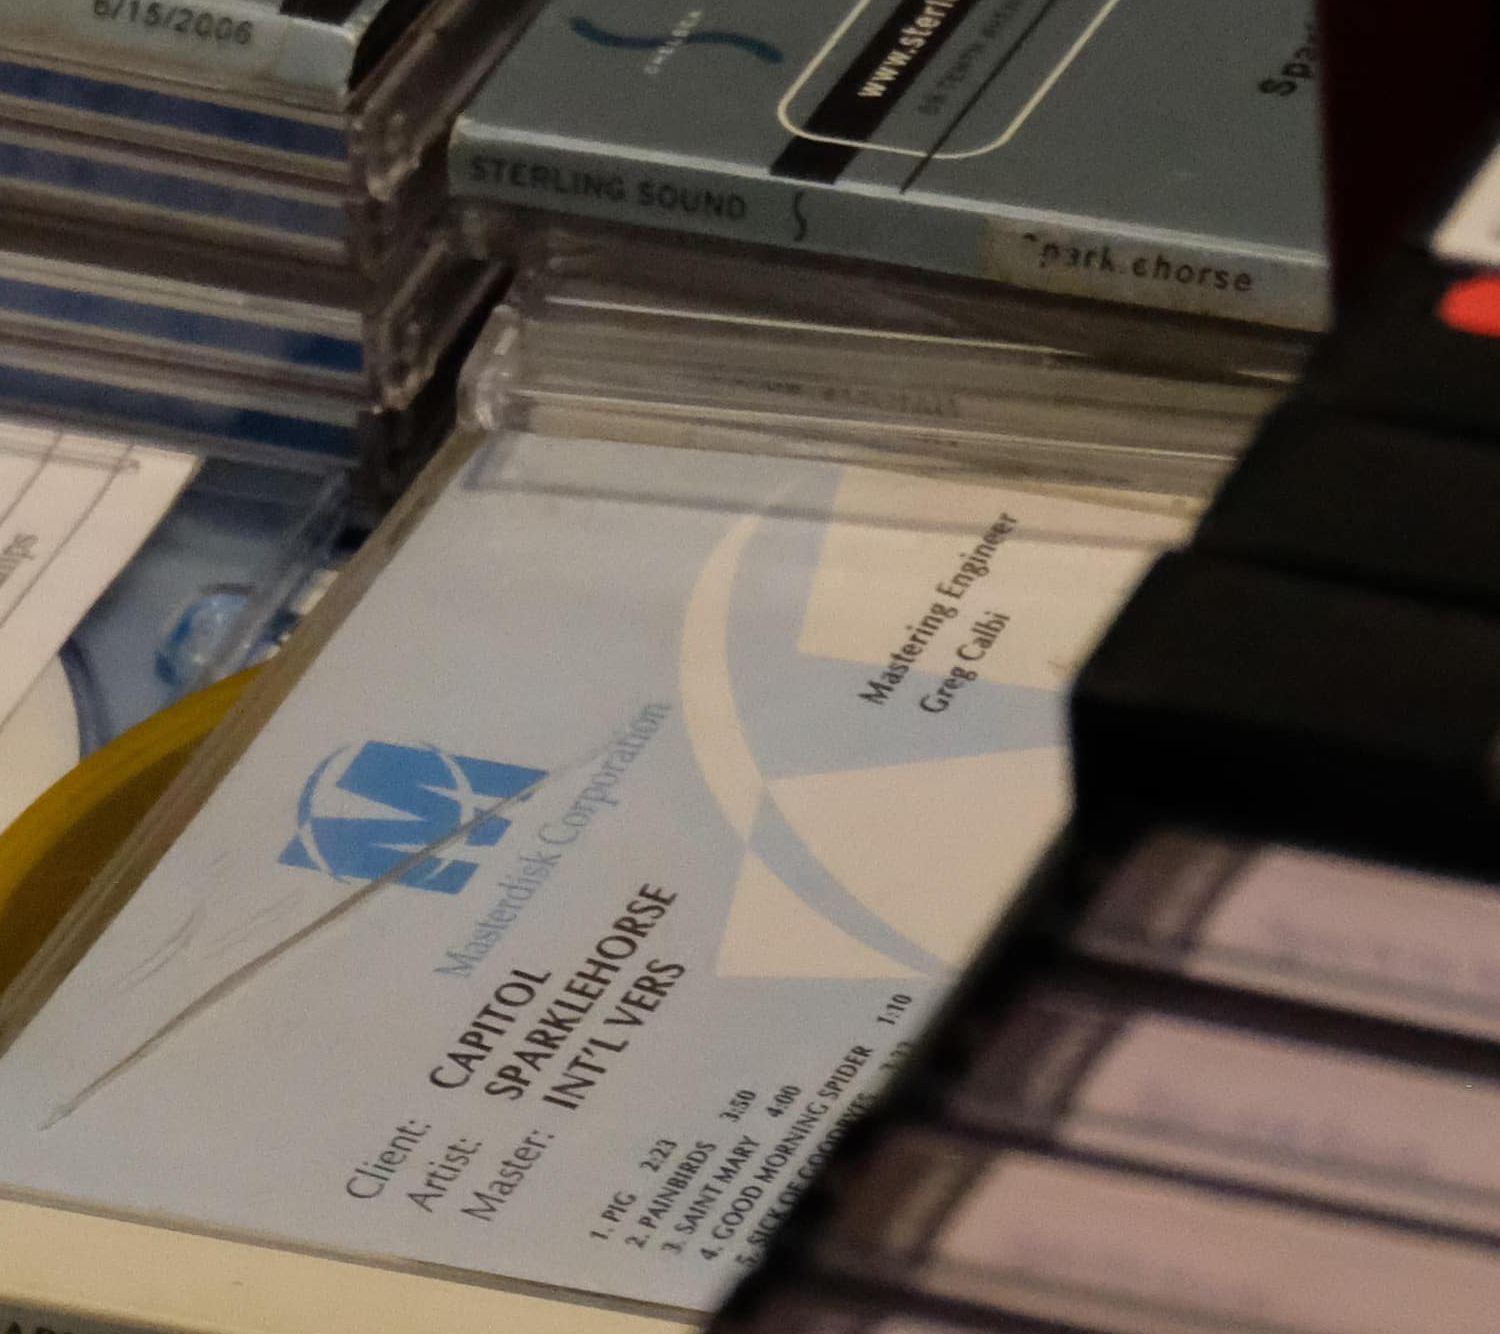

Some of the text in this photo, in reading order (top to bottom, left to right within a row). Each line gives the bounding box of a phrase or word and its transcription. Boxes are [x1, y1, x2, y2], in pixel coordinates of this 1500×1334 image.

[466, 155, 748, 223] STERLING SOUND
[857, 512, 1018, 707] Mastering Engineer
[919, 610, 1011, 714] Greg Calbi
[432, 701, 674, 981] Masterdisk Corporation
[345, 967, 552, 1201] Client: CAPITOL
[406, 882, 680, 1215] Artist: SPARKLEHORSE
[459, 958, 686, 1224] Master: INT'L VERS
[699, 992, 914, 1262] 4. GOOD MORNING SPIDER 1:10
[589, 1138, 680, 1242] 1. PIG 2:23
[624, 1088, 758, 1251] 2. PAINBIRDS 3:50
[661, 1084, 803, 1257] 3. SAINT MARY 4:00
